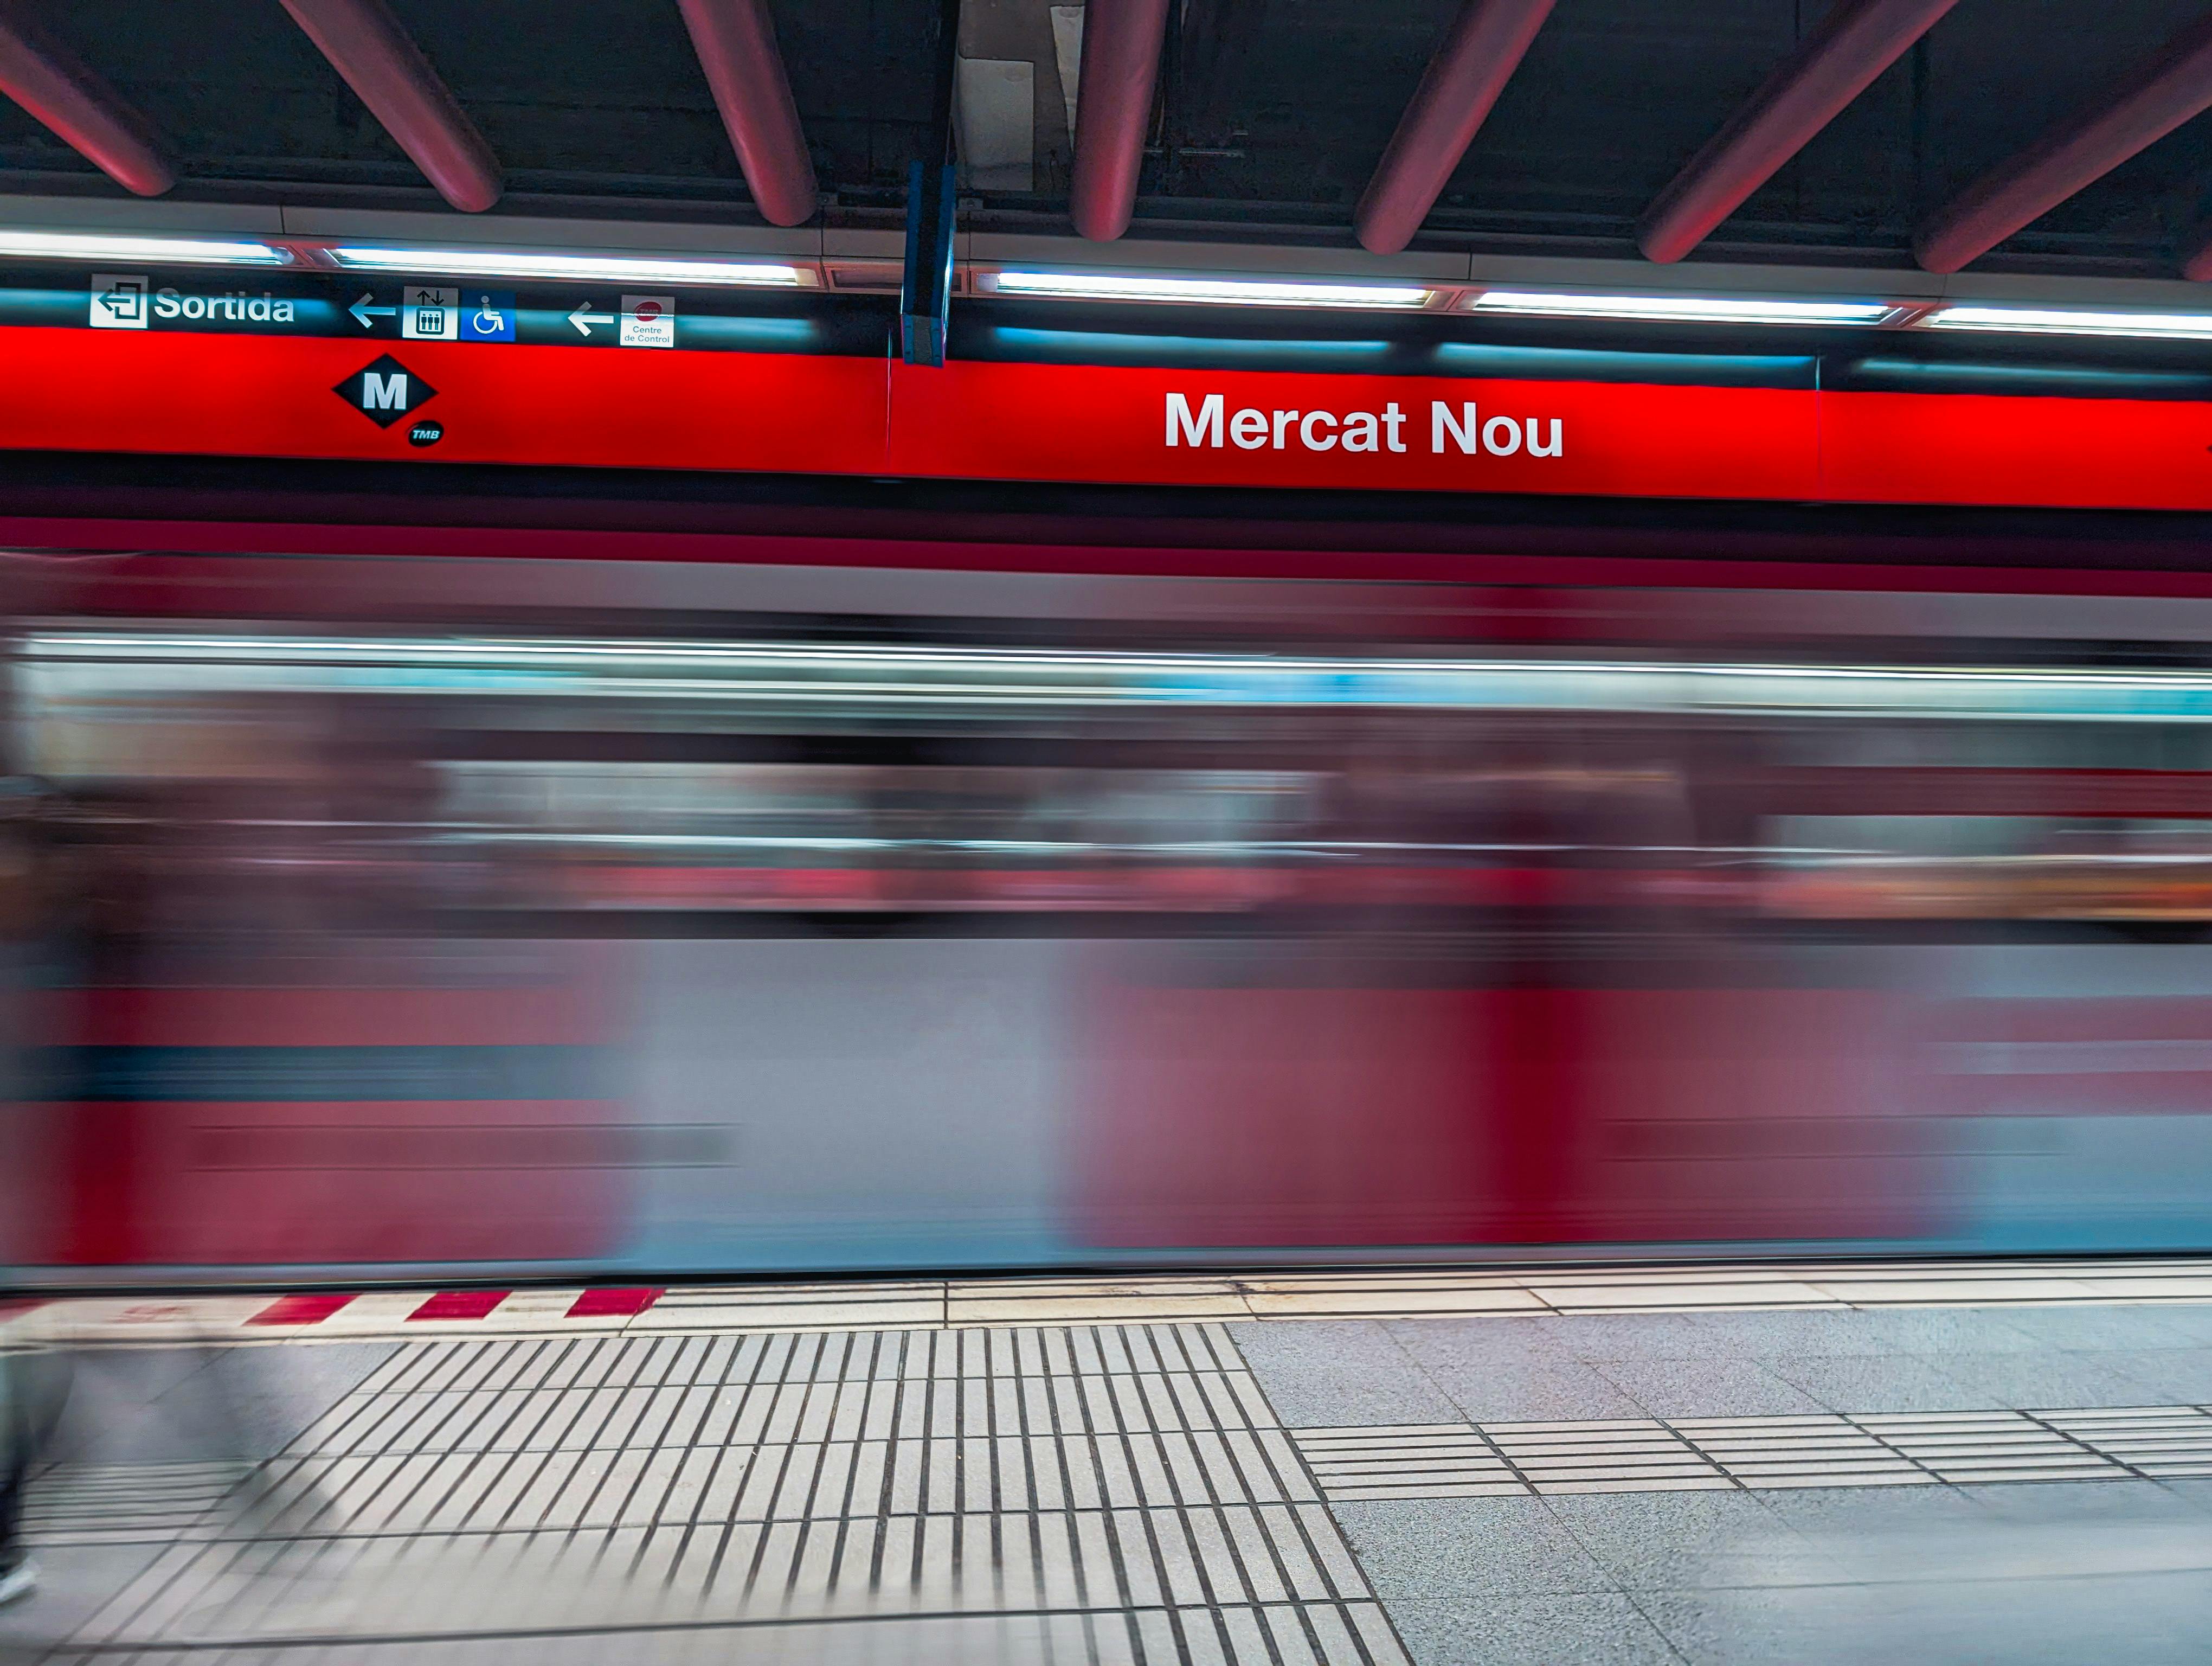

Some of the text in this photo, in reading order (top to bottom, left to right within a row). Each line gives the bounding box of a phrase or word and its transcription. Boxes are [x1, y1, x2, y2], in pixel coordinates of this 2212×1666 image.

[153, 287, 294, 322] Sortida
[363, 372, 407, 411] M
[413, 429, 440, 440] TMB
[1166, 393, 1562, 457] Mercat Nou
